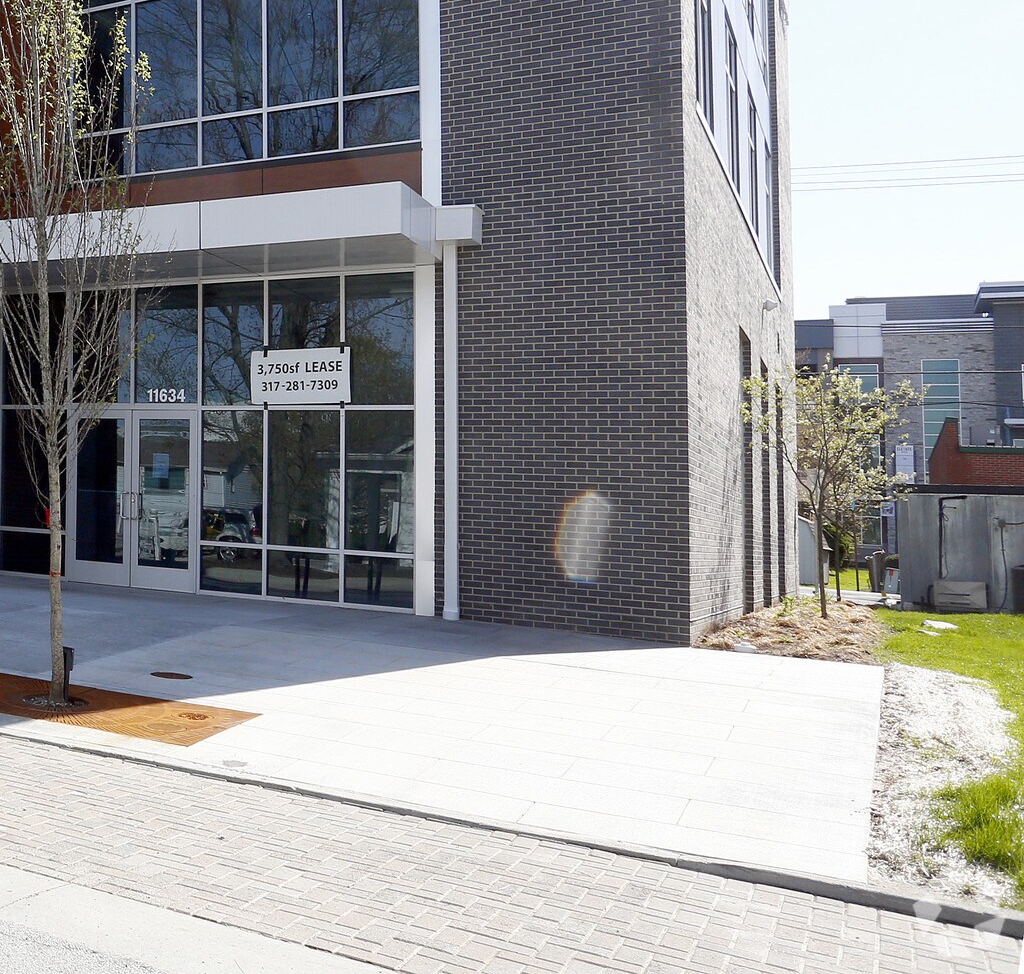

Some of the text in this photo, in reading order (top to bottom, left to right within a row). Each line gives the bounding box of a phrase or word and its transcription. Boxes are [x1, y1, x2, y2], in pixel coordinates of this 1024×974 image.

[257, 360, 343, 376] 3,750sf LEASE
[261, 379, 339, 392] 317-281-7309
[147, 388, 186, 403] 11634
